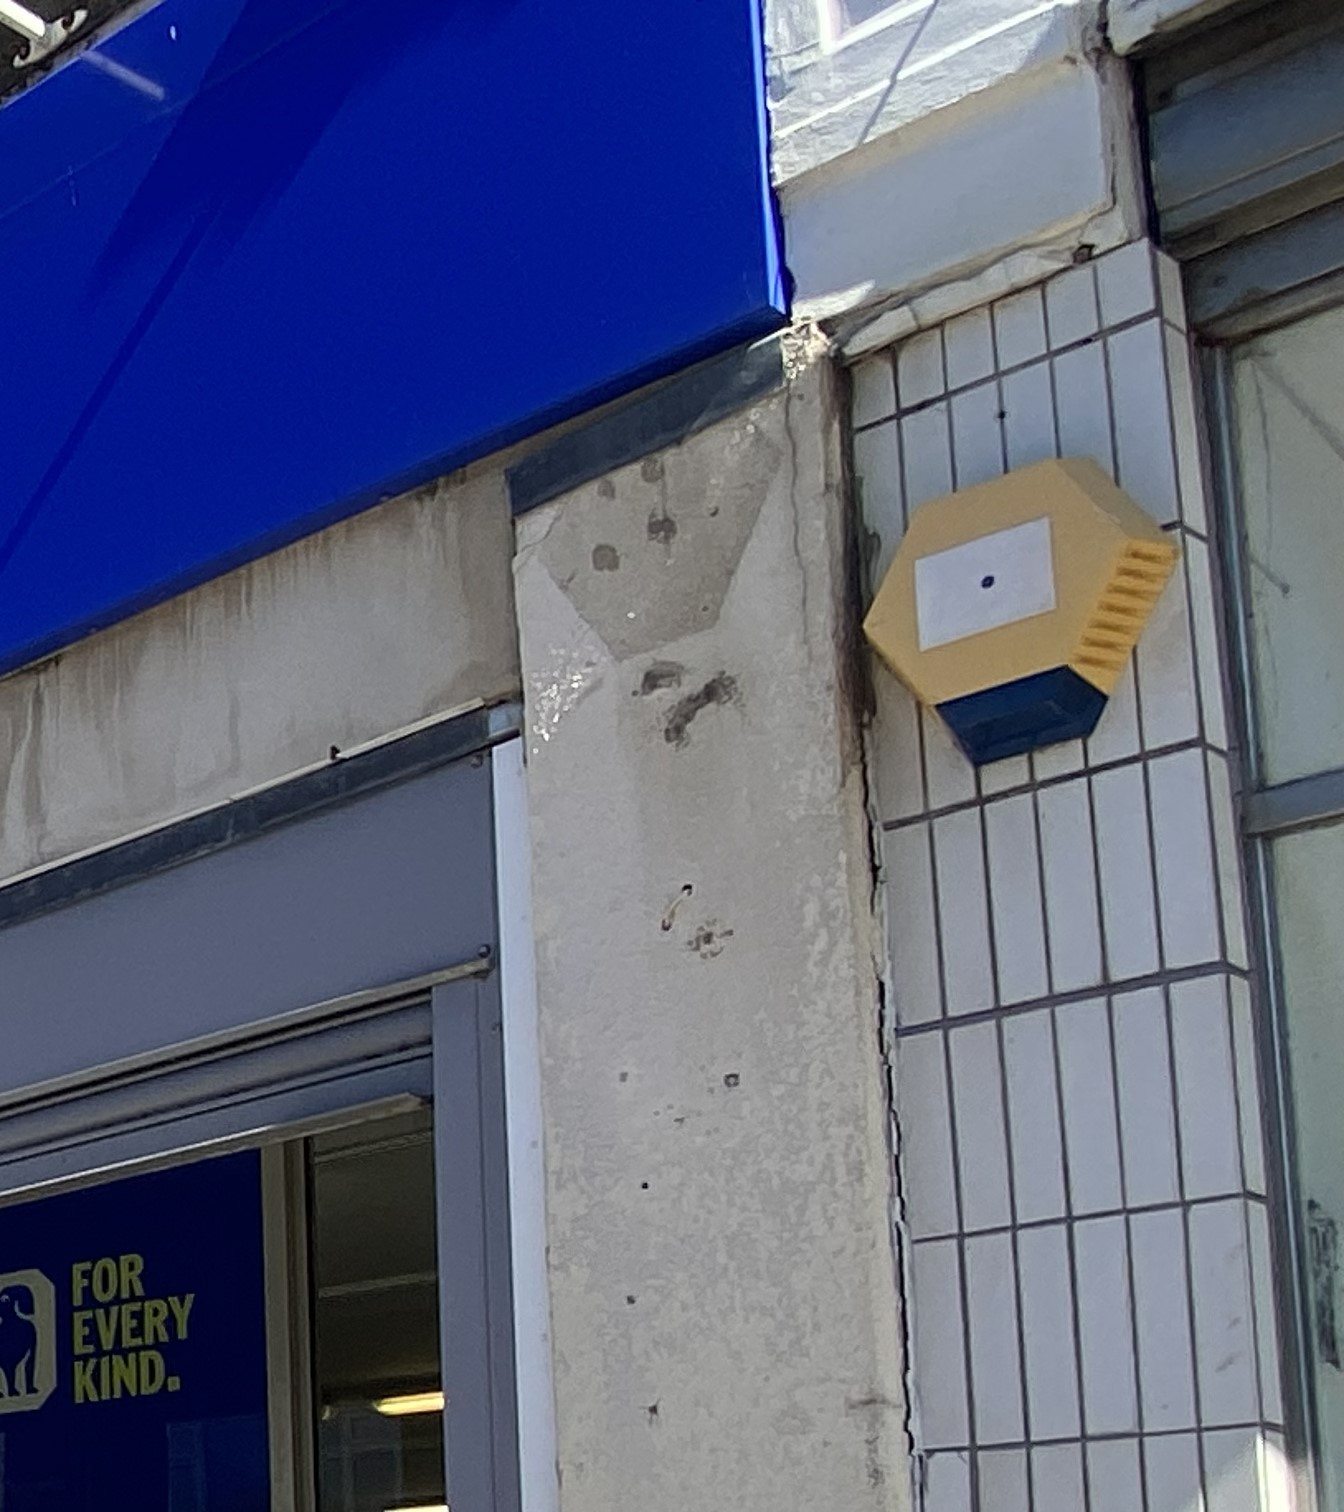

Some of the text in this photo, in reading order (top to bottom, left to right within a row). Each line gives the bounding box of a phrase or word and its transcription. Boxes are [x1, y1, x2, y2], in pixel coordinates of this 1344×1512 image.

[72, 1254, 144, 1306] FOR
[72, 1294, 195, 1356] EVERY
[73, 1350, 181, 1404] KIND.
